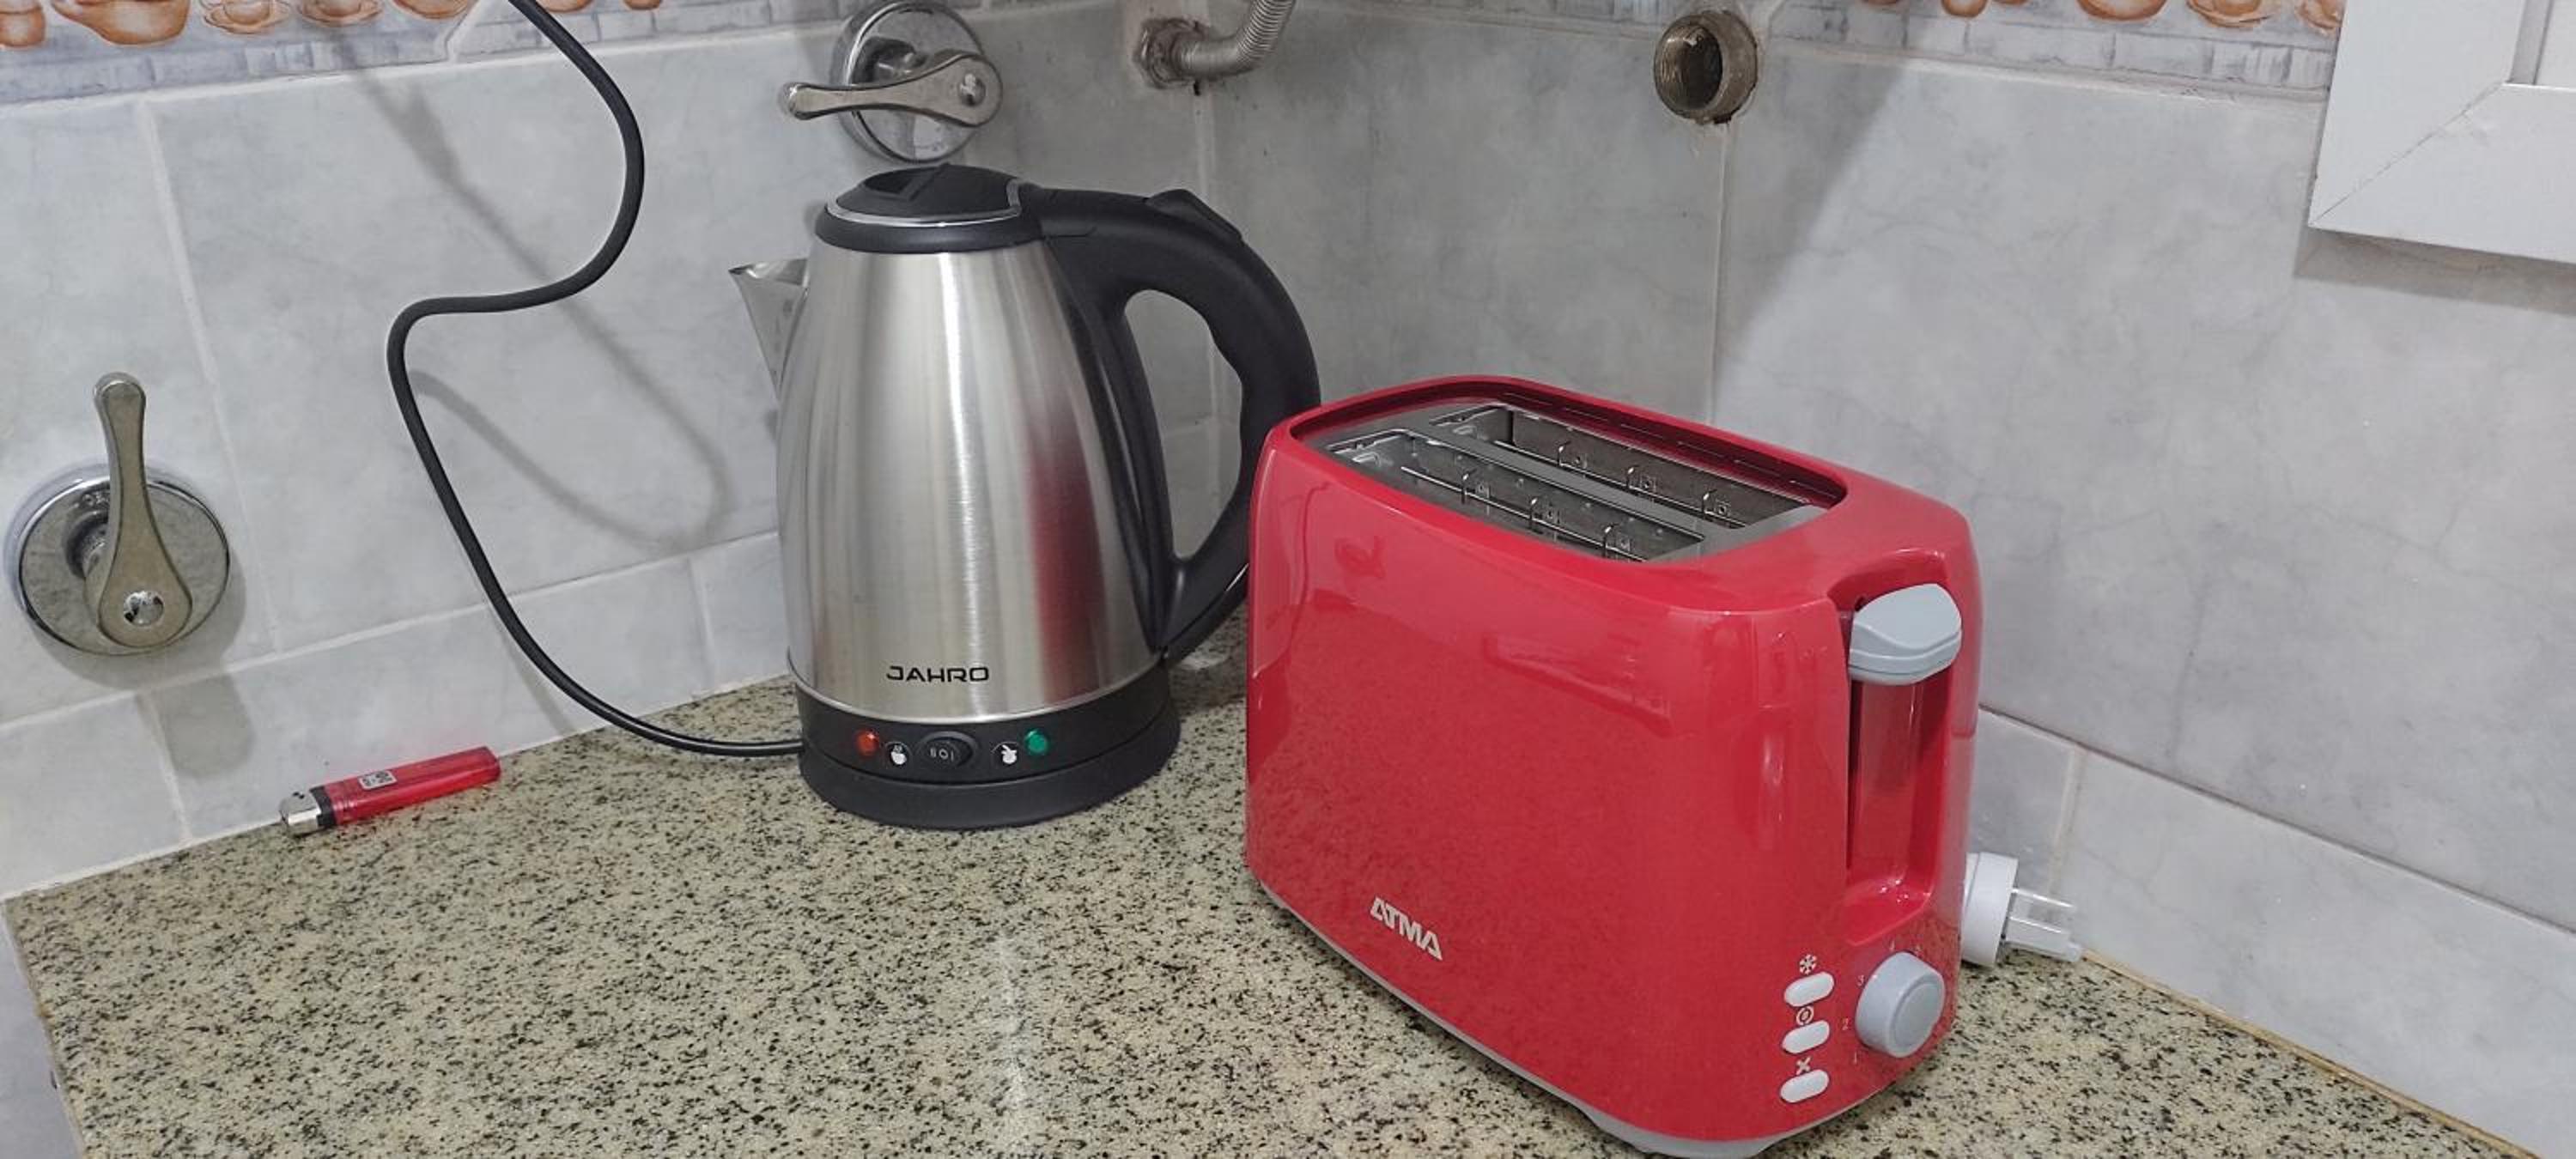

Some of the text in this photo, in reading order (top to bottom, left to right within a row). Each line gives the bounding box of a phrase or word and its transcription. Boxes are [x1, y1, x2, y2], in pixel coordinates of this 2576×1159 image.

[886, 665, 989, 683] JAHRO
[1370, 896, 1443, 961] ATMA
[1841, 1017, 1849, 1031] 2
